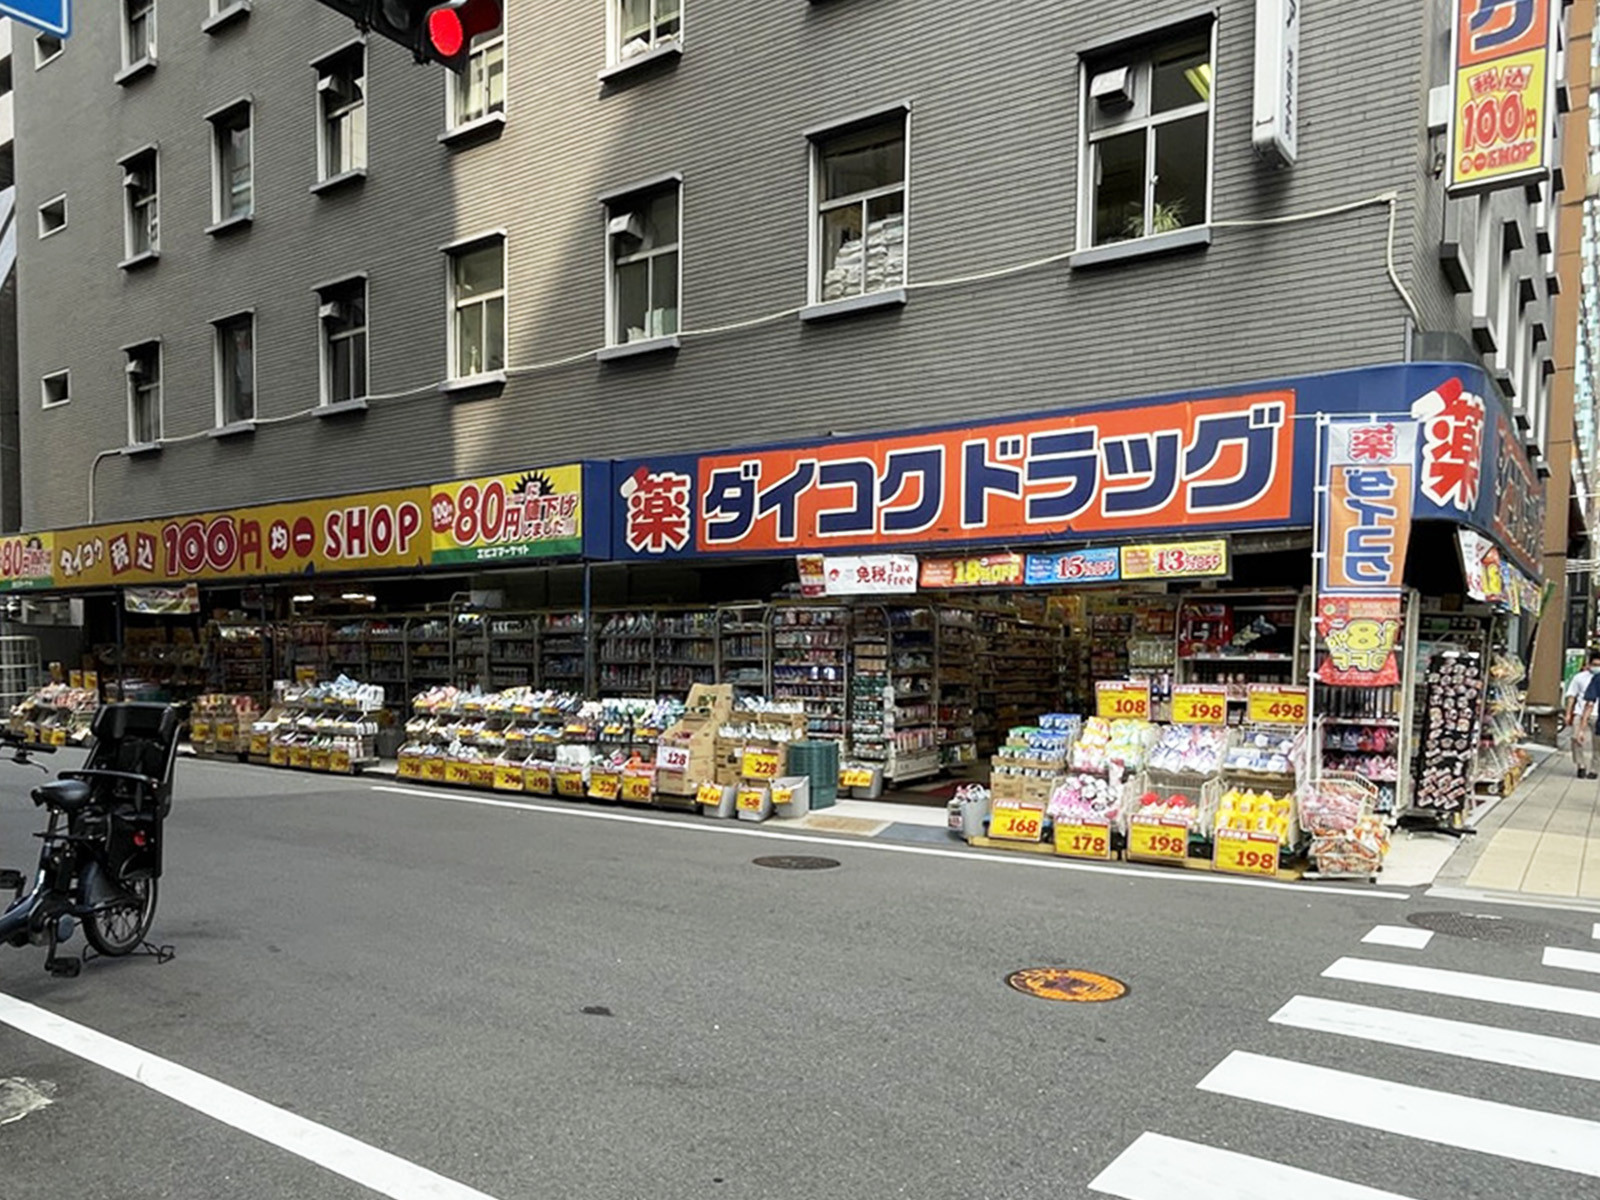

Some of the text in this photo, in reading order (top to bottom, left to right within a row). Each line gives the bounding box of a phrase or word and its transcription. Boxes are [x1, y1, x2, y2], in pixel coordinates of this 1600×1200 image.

[1468, 65, 1533, 96] 税込
[1463, 91, 1537, 152] 100円
[1487, 140, 1536, 169] SHOP
[1411, 377, 1486, 510] 薬
[622, 467, 691, 552] 薬
[109, 534, 155, 573] 税込
[162, 515, 261, 577] 100円
[324, 502, 421, 560] SHOP
[856, 566, 886, 583] 免税
[889, 561, 911, 572] Tax
[887, 572, 914, 586] Free
[1115, 699, 1146, 714] 108
[1190, 704, 1222, 719] 198
[1269, 702, 1304, 719] 498
[667, 750, 688, 767] 128
[755, 760, 778, 775] 228
[1007, 819, 1038, 834] 168
[1072, 836, 1105, 851] 178
[1149, 836, 1183, 853] 198
[1237, 850, 1274, 869] 198
